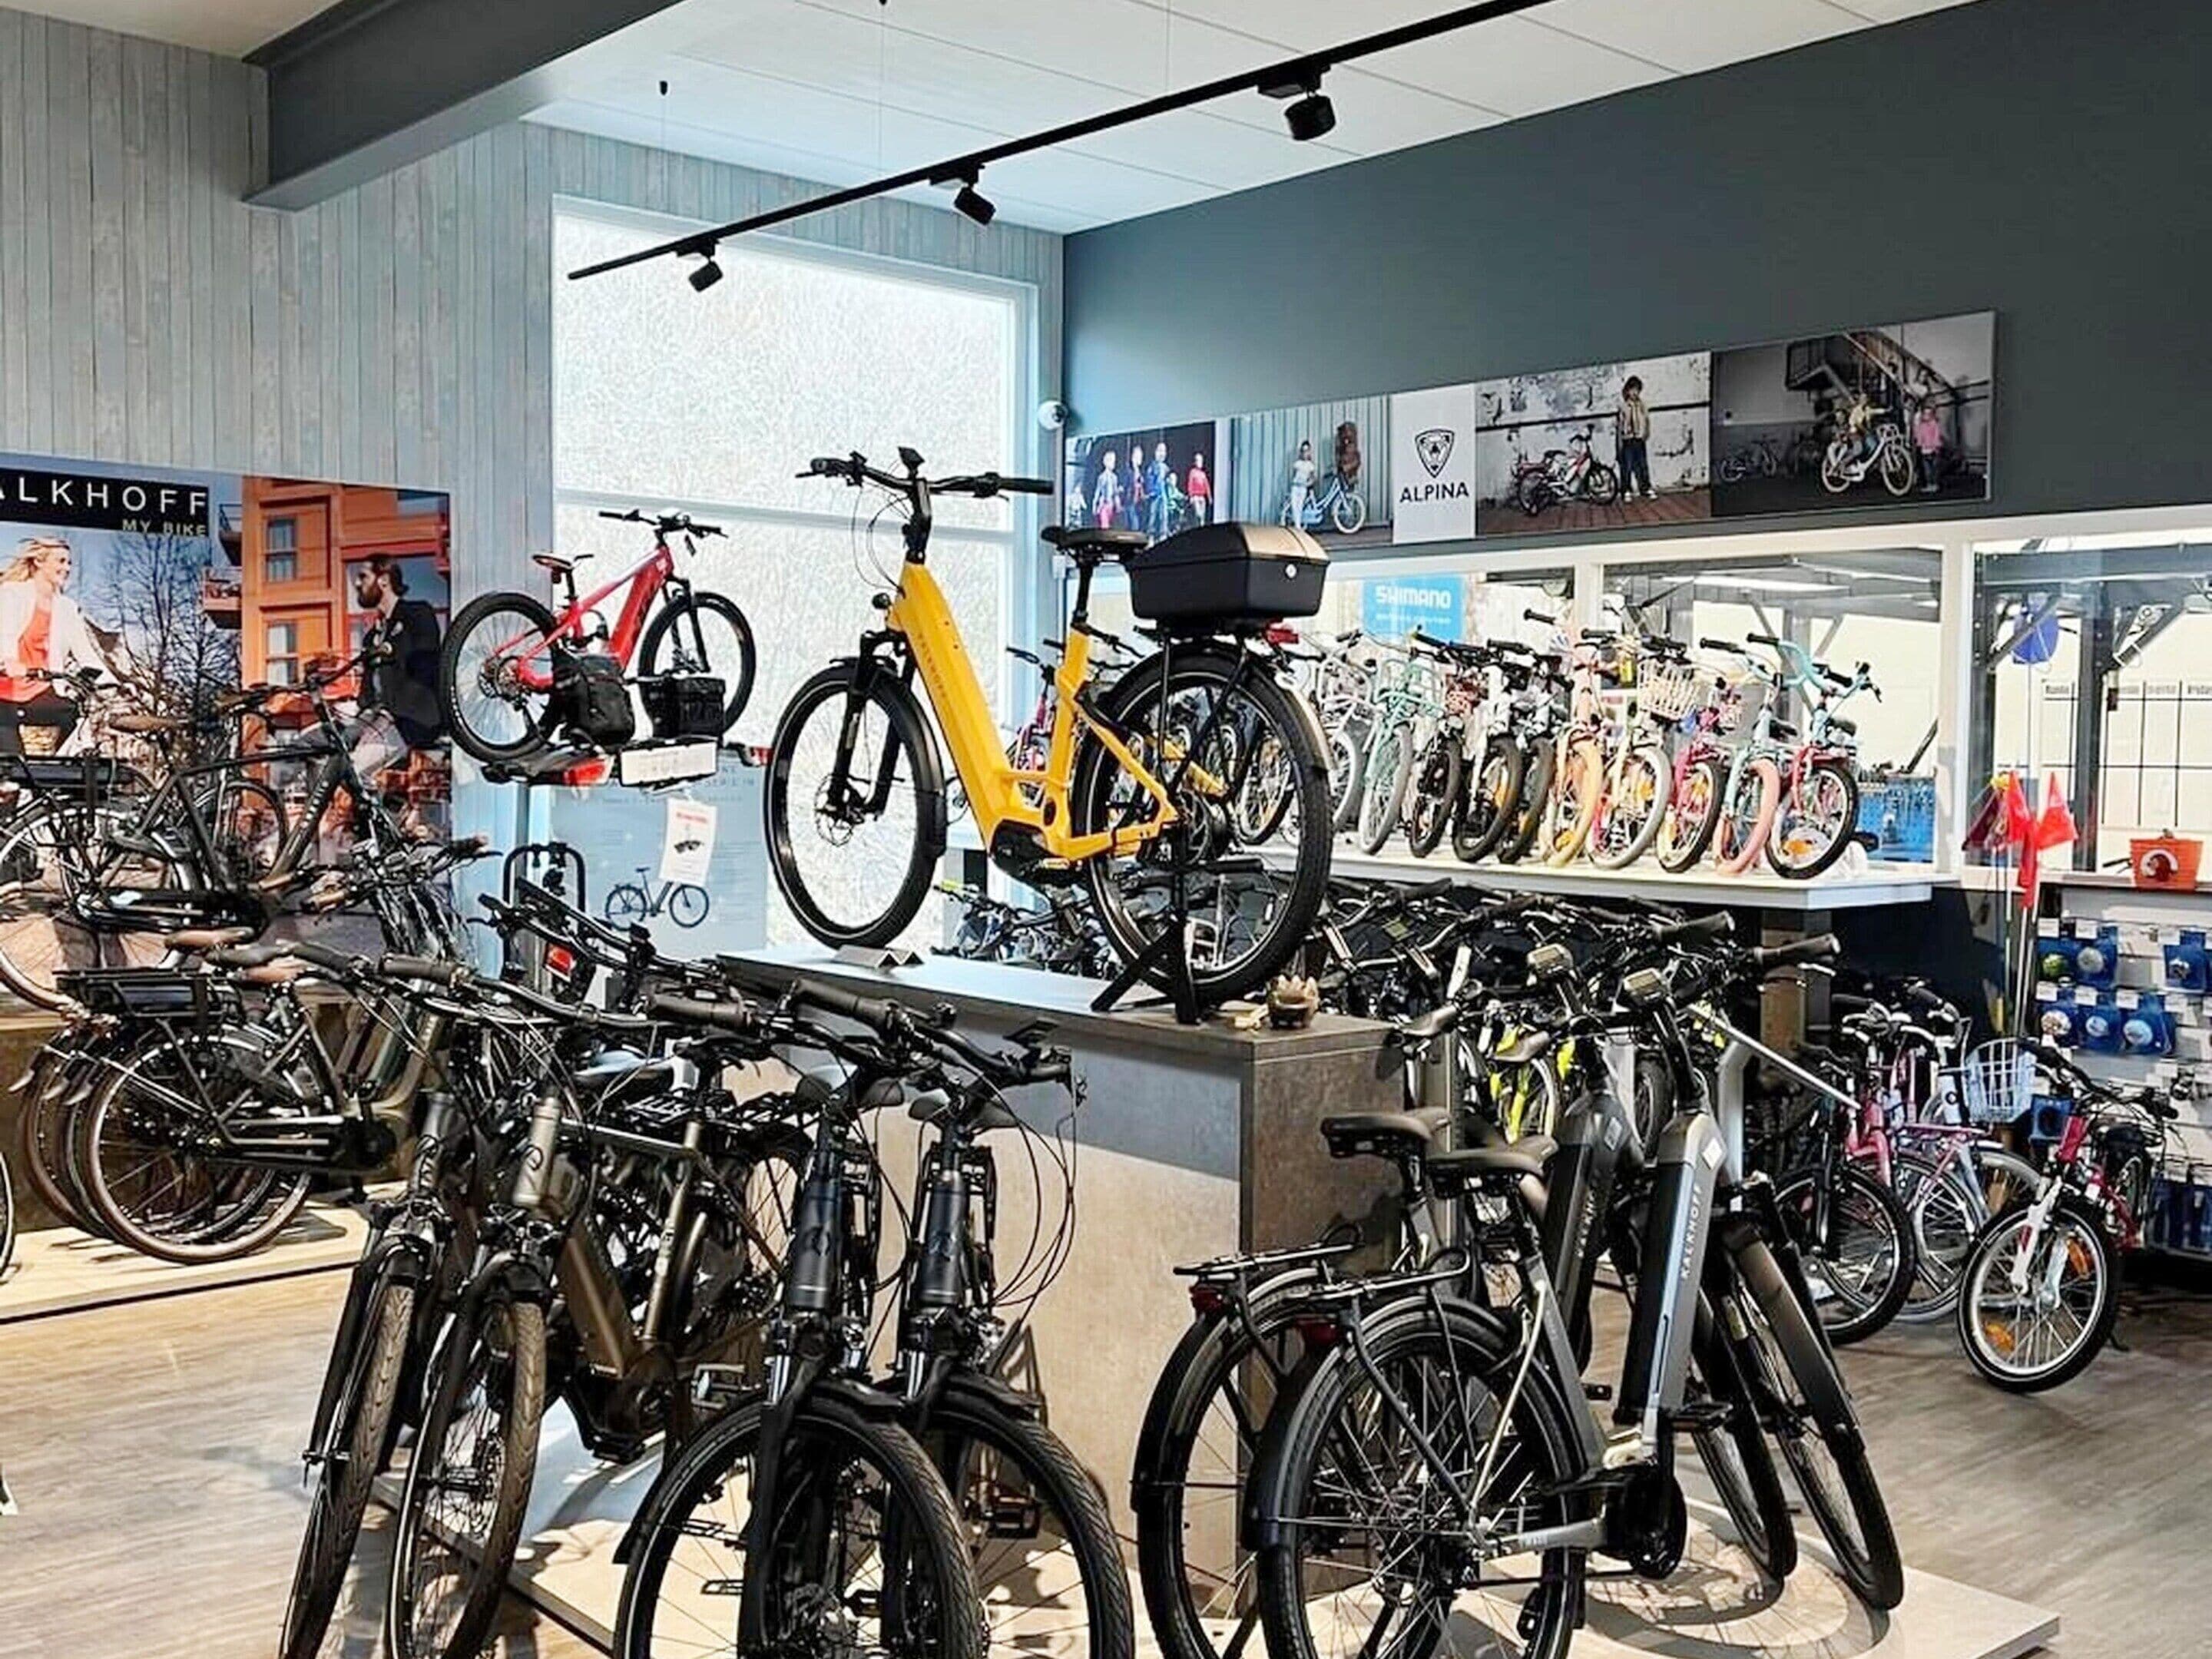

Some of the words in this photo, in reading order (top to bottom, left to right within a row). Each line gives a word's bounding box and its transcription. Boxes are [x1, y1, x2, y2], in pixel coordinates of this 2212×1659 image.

[0, 477, 206, 515] LKHOFF
[1399, 482, 1469, 503] ALPINA
[122, 518, 151, 533] MY
[163, 522, 207, 538] BIKE
[1375, 584, 1452, 609] SHIMANO
[1681, 1183, 1702, 1280] KALKHOFF
